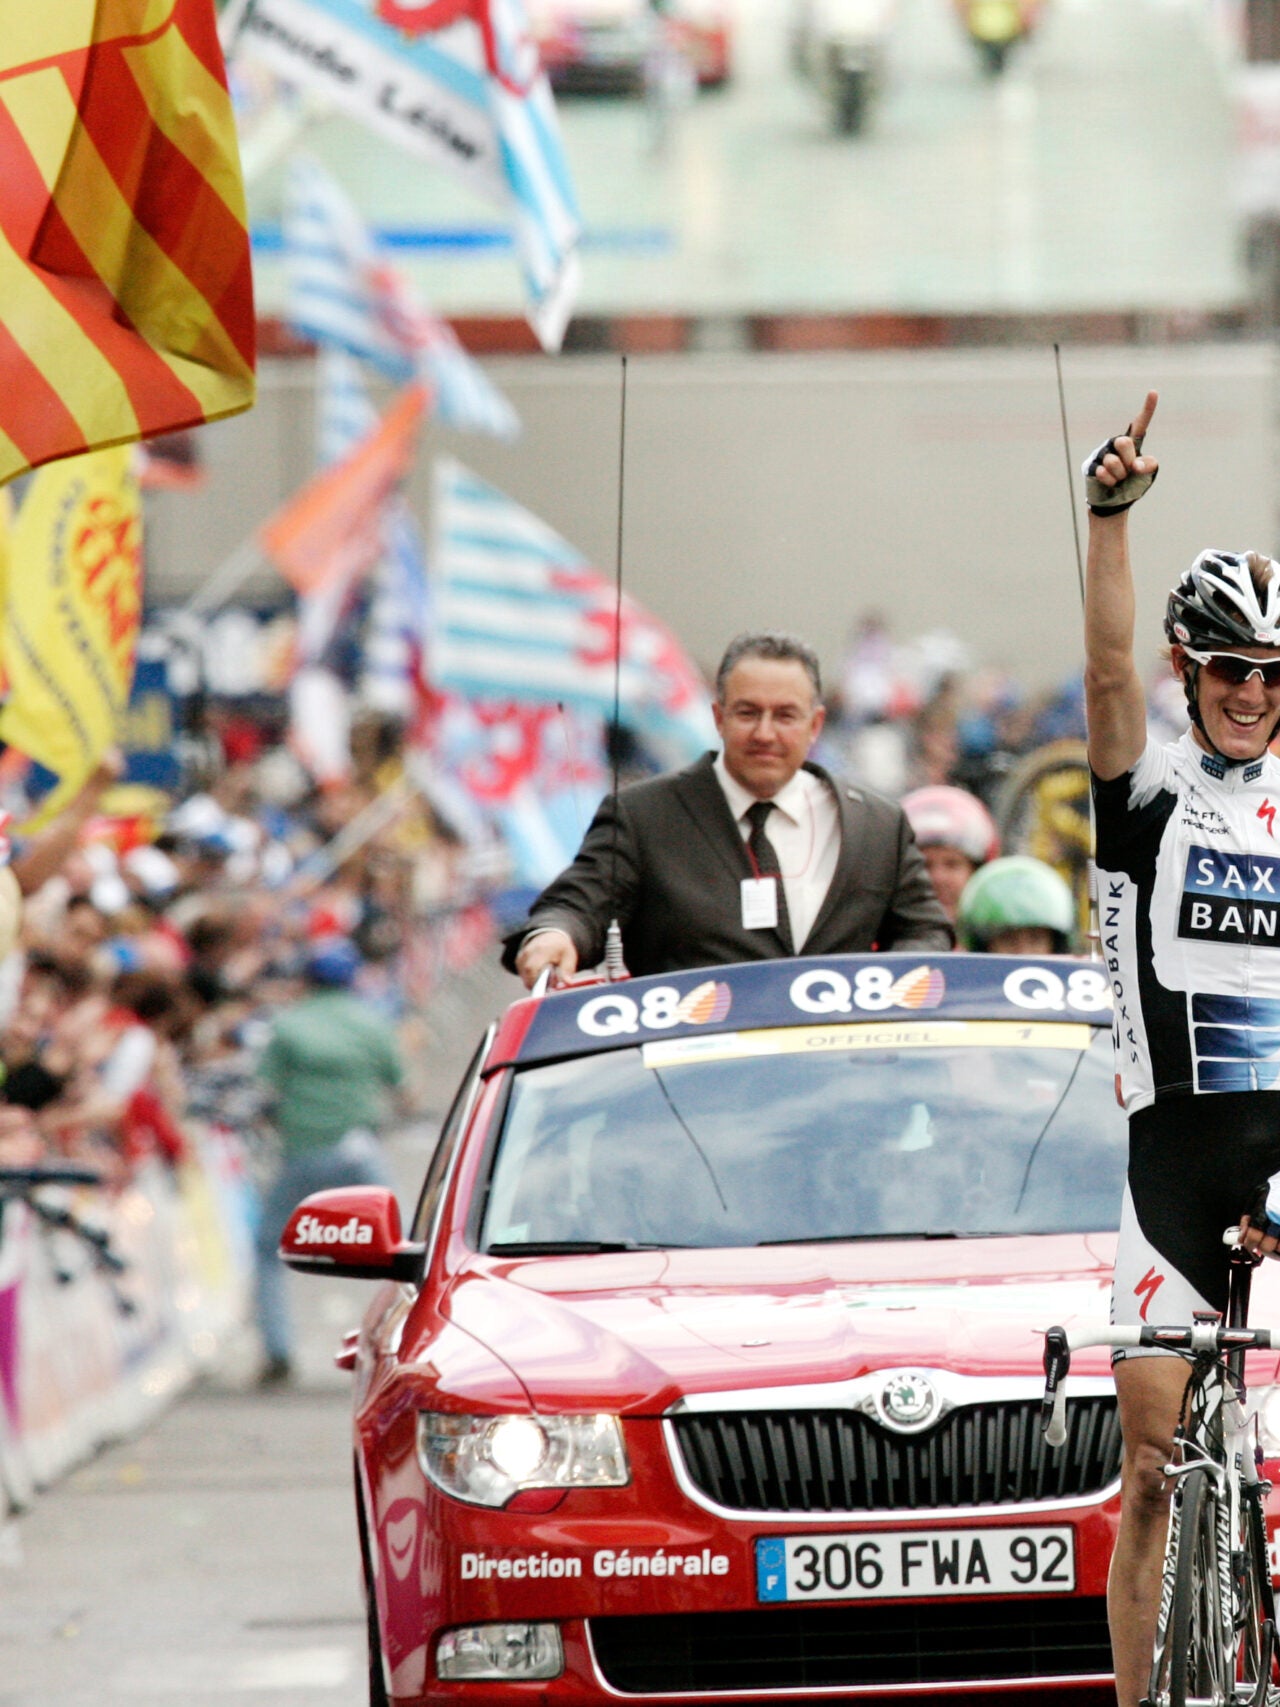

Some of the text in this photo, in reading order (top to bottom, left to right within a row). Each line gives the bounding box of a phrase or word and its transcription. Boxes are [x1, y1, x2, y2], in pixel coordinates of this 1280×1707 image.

[789, 966, 895, 1014] Q8
[1003, 966, 1108, 1012] Q8
[577, 986, 681, 1036] Q8
[806, 1031, 940, 1047] OFFICIEL
[294, 1214, 374, 1245] Škoda
[460, 1548, 730, 1580] Direction Générale
[766, 1575, 779, 1592] F
[793, 1536, 1070, 1592] 306 FWA 92
